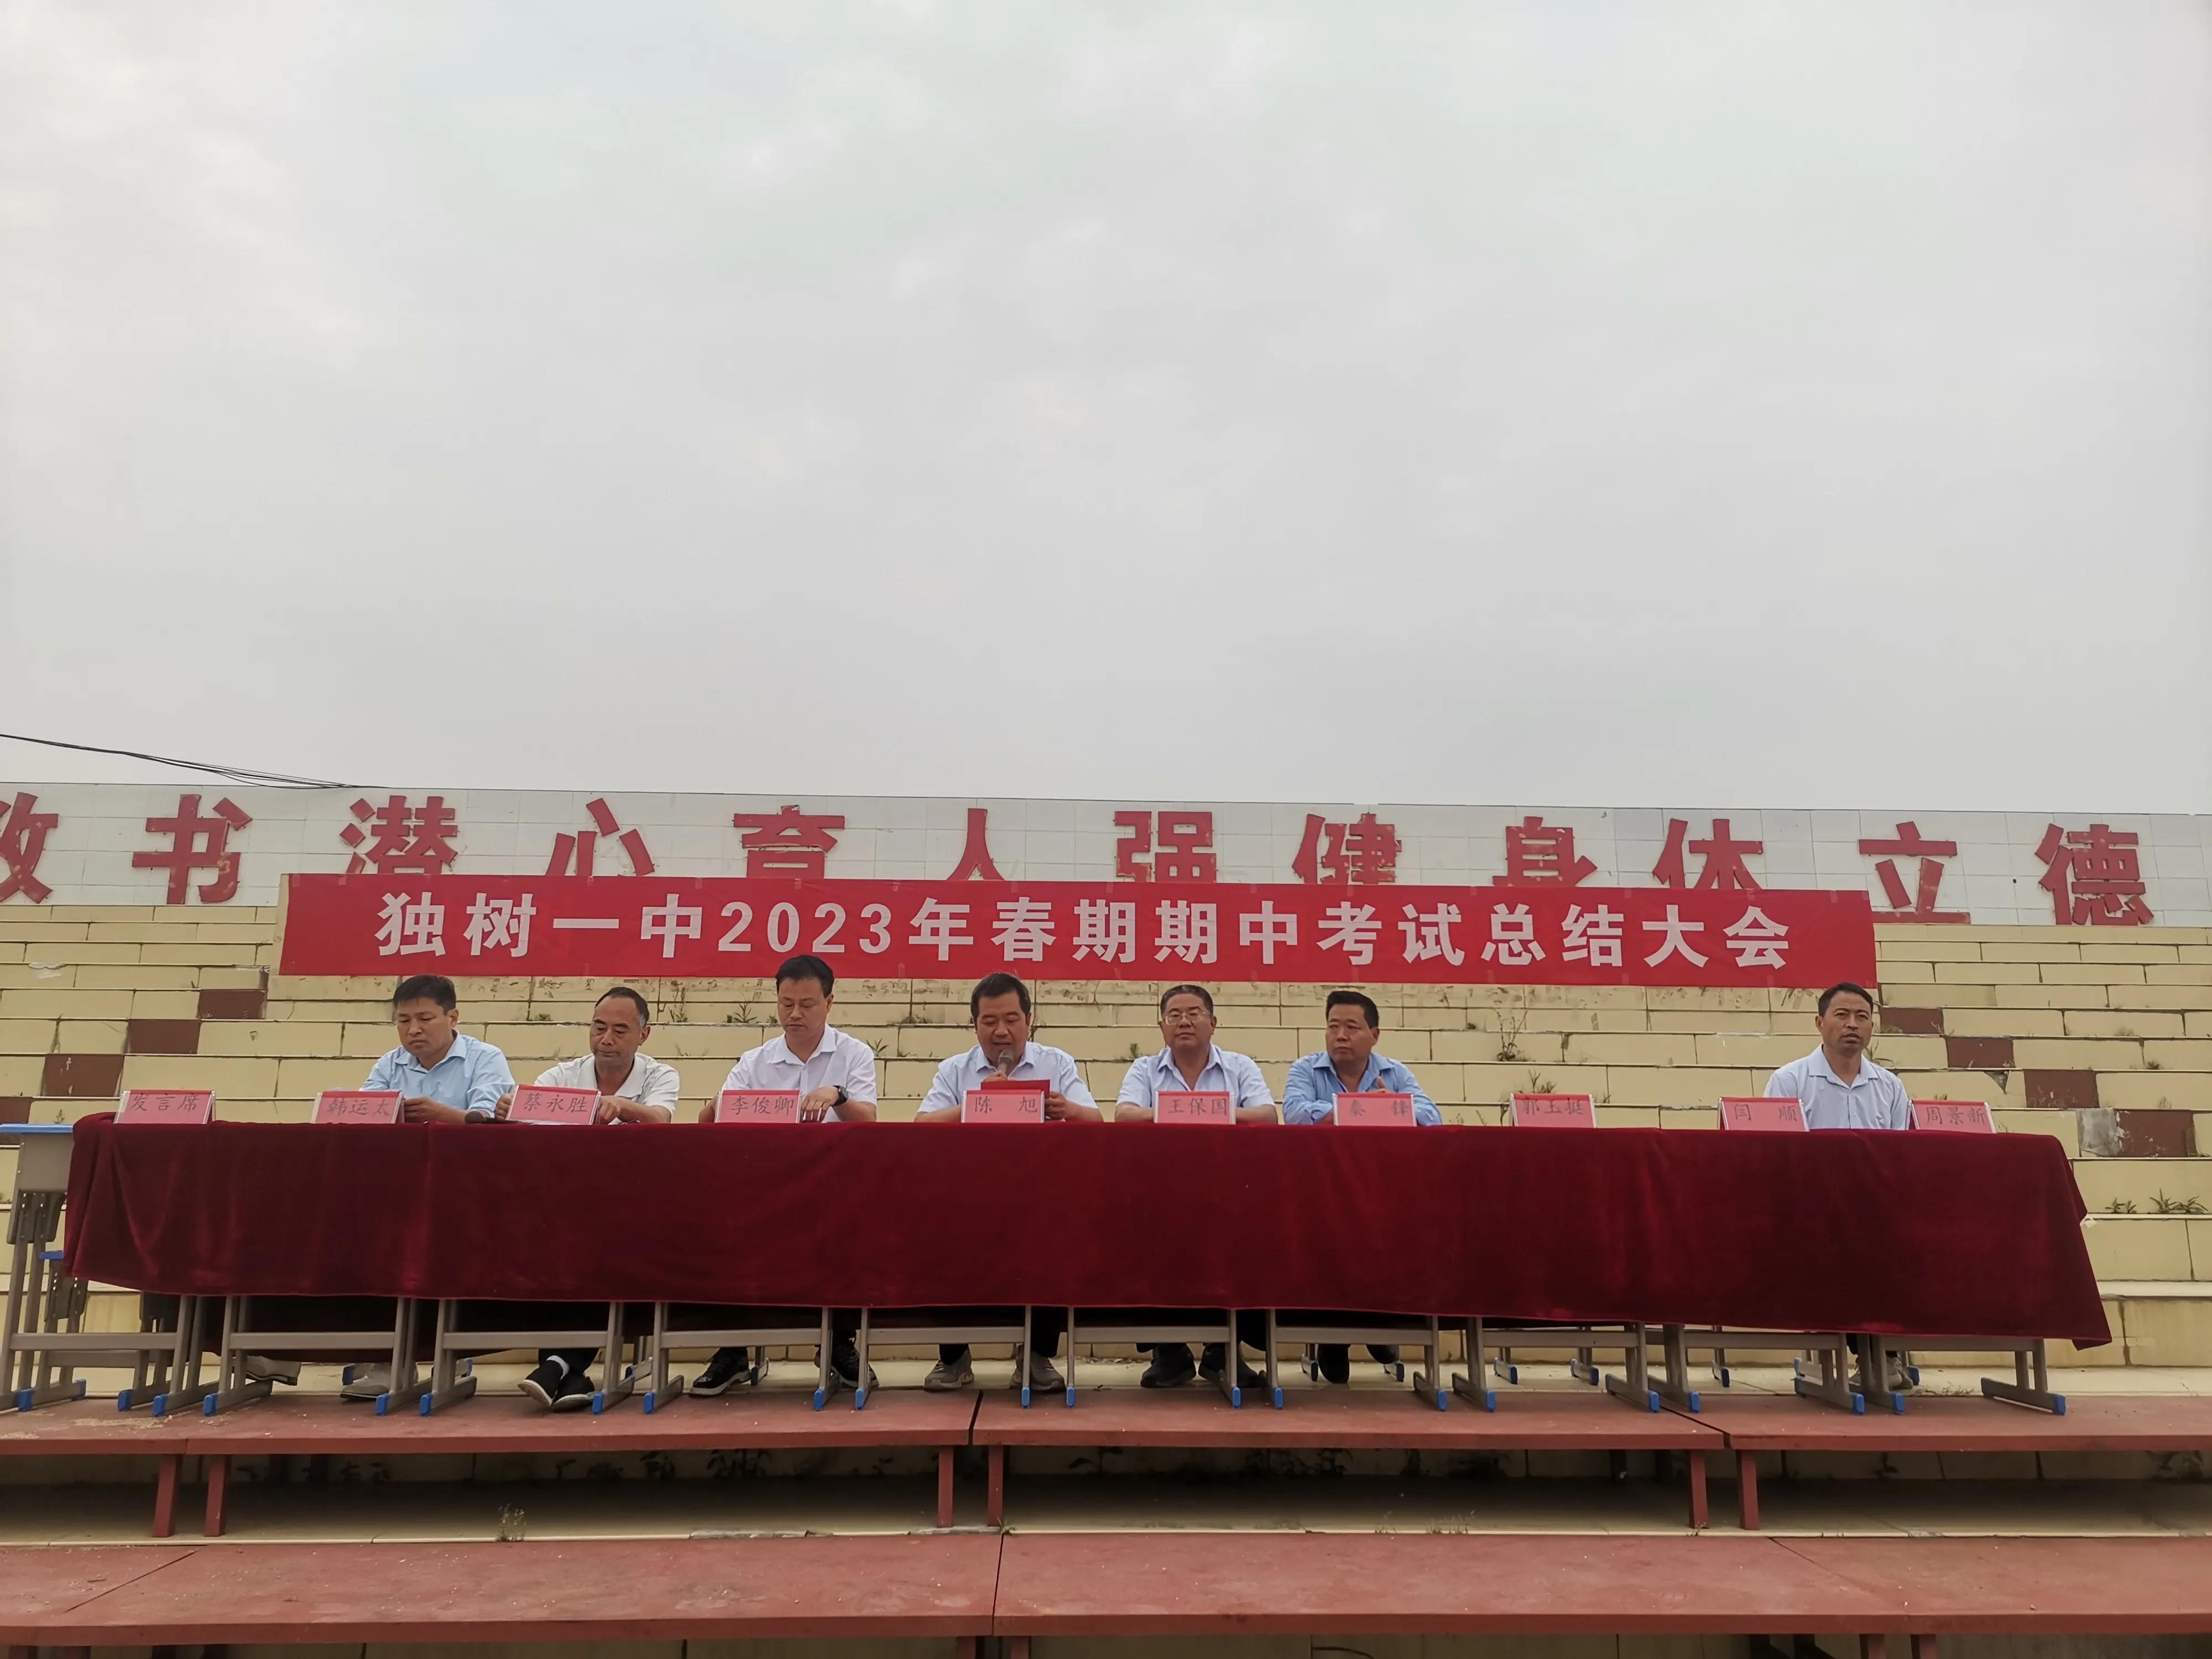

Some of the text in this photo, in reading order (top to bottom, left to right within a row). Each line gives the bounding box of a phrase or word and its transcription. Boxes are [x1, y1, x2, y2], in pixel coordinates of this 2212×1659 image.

[375, 891, 1789, 969] 独树一中2023年春期期中考试总结大会
[131, 1093, 200, 1112] 发言席
[524, 1093, 587, 1113] 蔡永胜
[731, 1095, 794, 1115] 李俊卿
[1167, 1098, 1227, 1115] 王保国
[1926, 1106, 1985, 1125] 周景新
